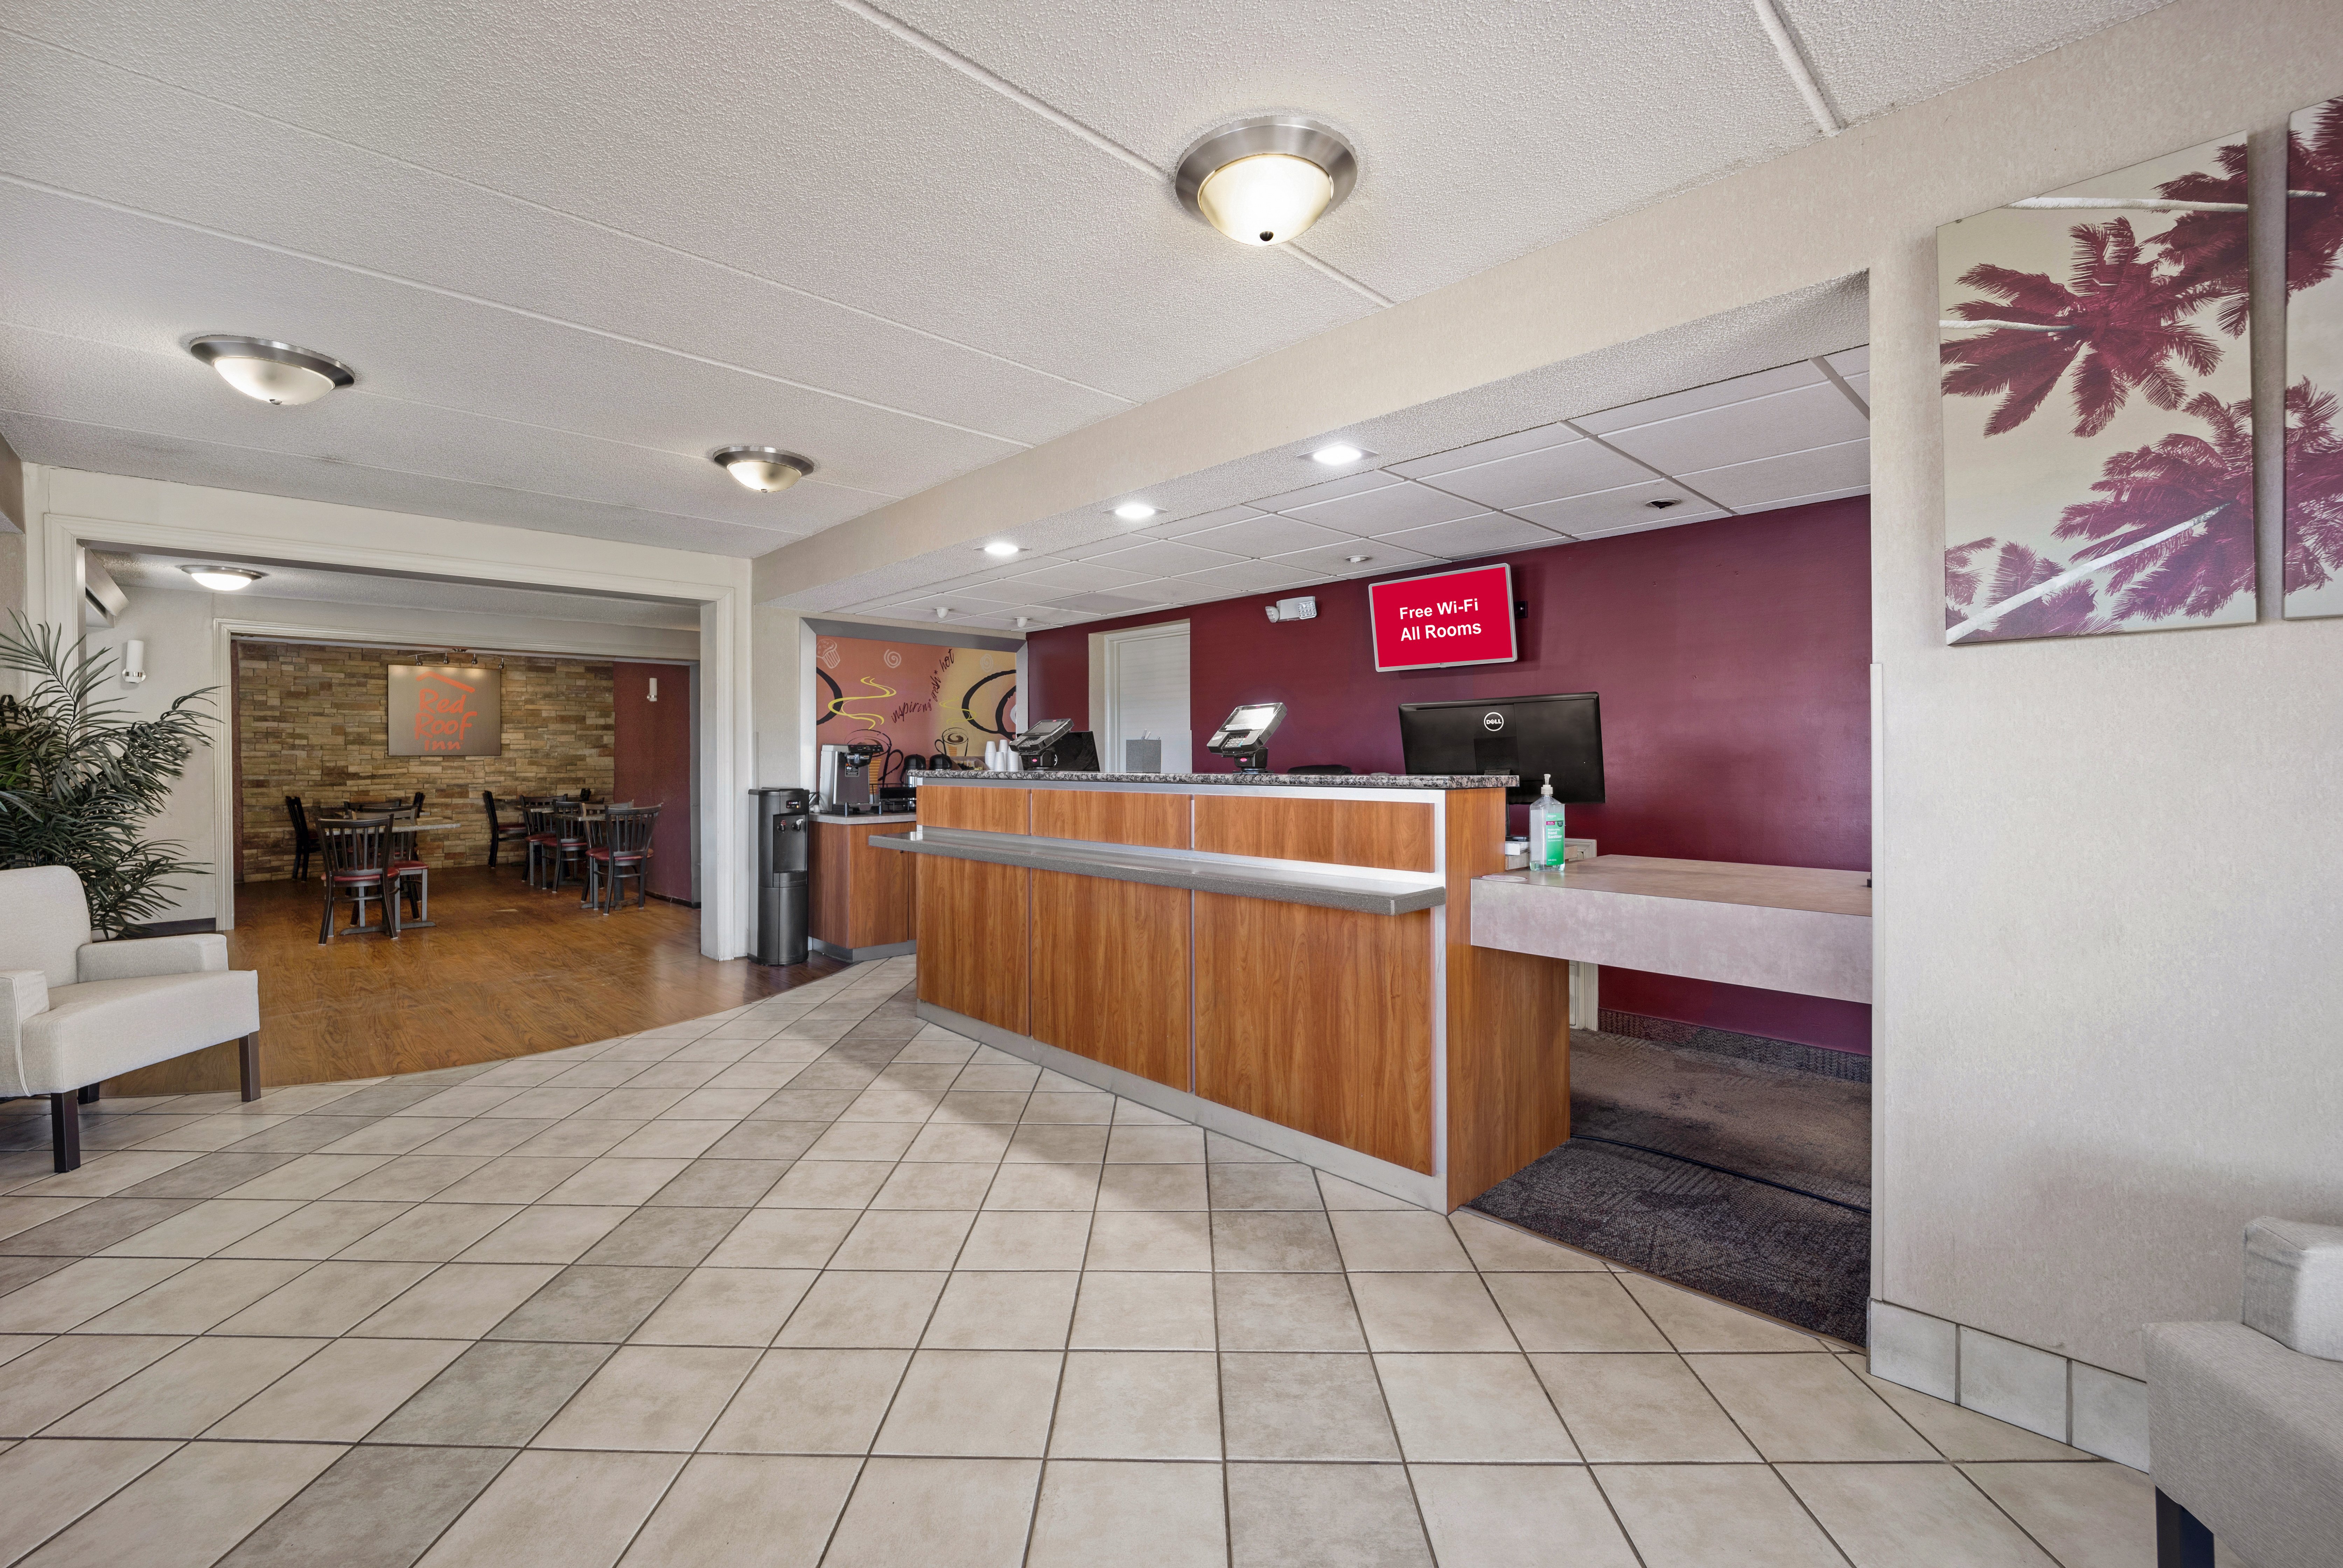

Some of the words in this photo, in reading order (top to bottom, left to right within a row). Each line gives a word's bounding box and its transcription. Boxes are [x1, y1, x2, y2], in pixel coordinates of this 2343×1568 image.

[1400, 607, 1433, 620] Free
[1436, 598, 1478, 615] Wi-Fi
[1401, 626, 1420, 641] All
[1425, 623, 1482, 639] Rooms
[939, 649, 954, 672] hot
[419, 688, 467, 714] Red
[414, 711, 478, 740] Roof
